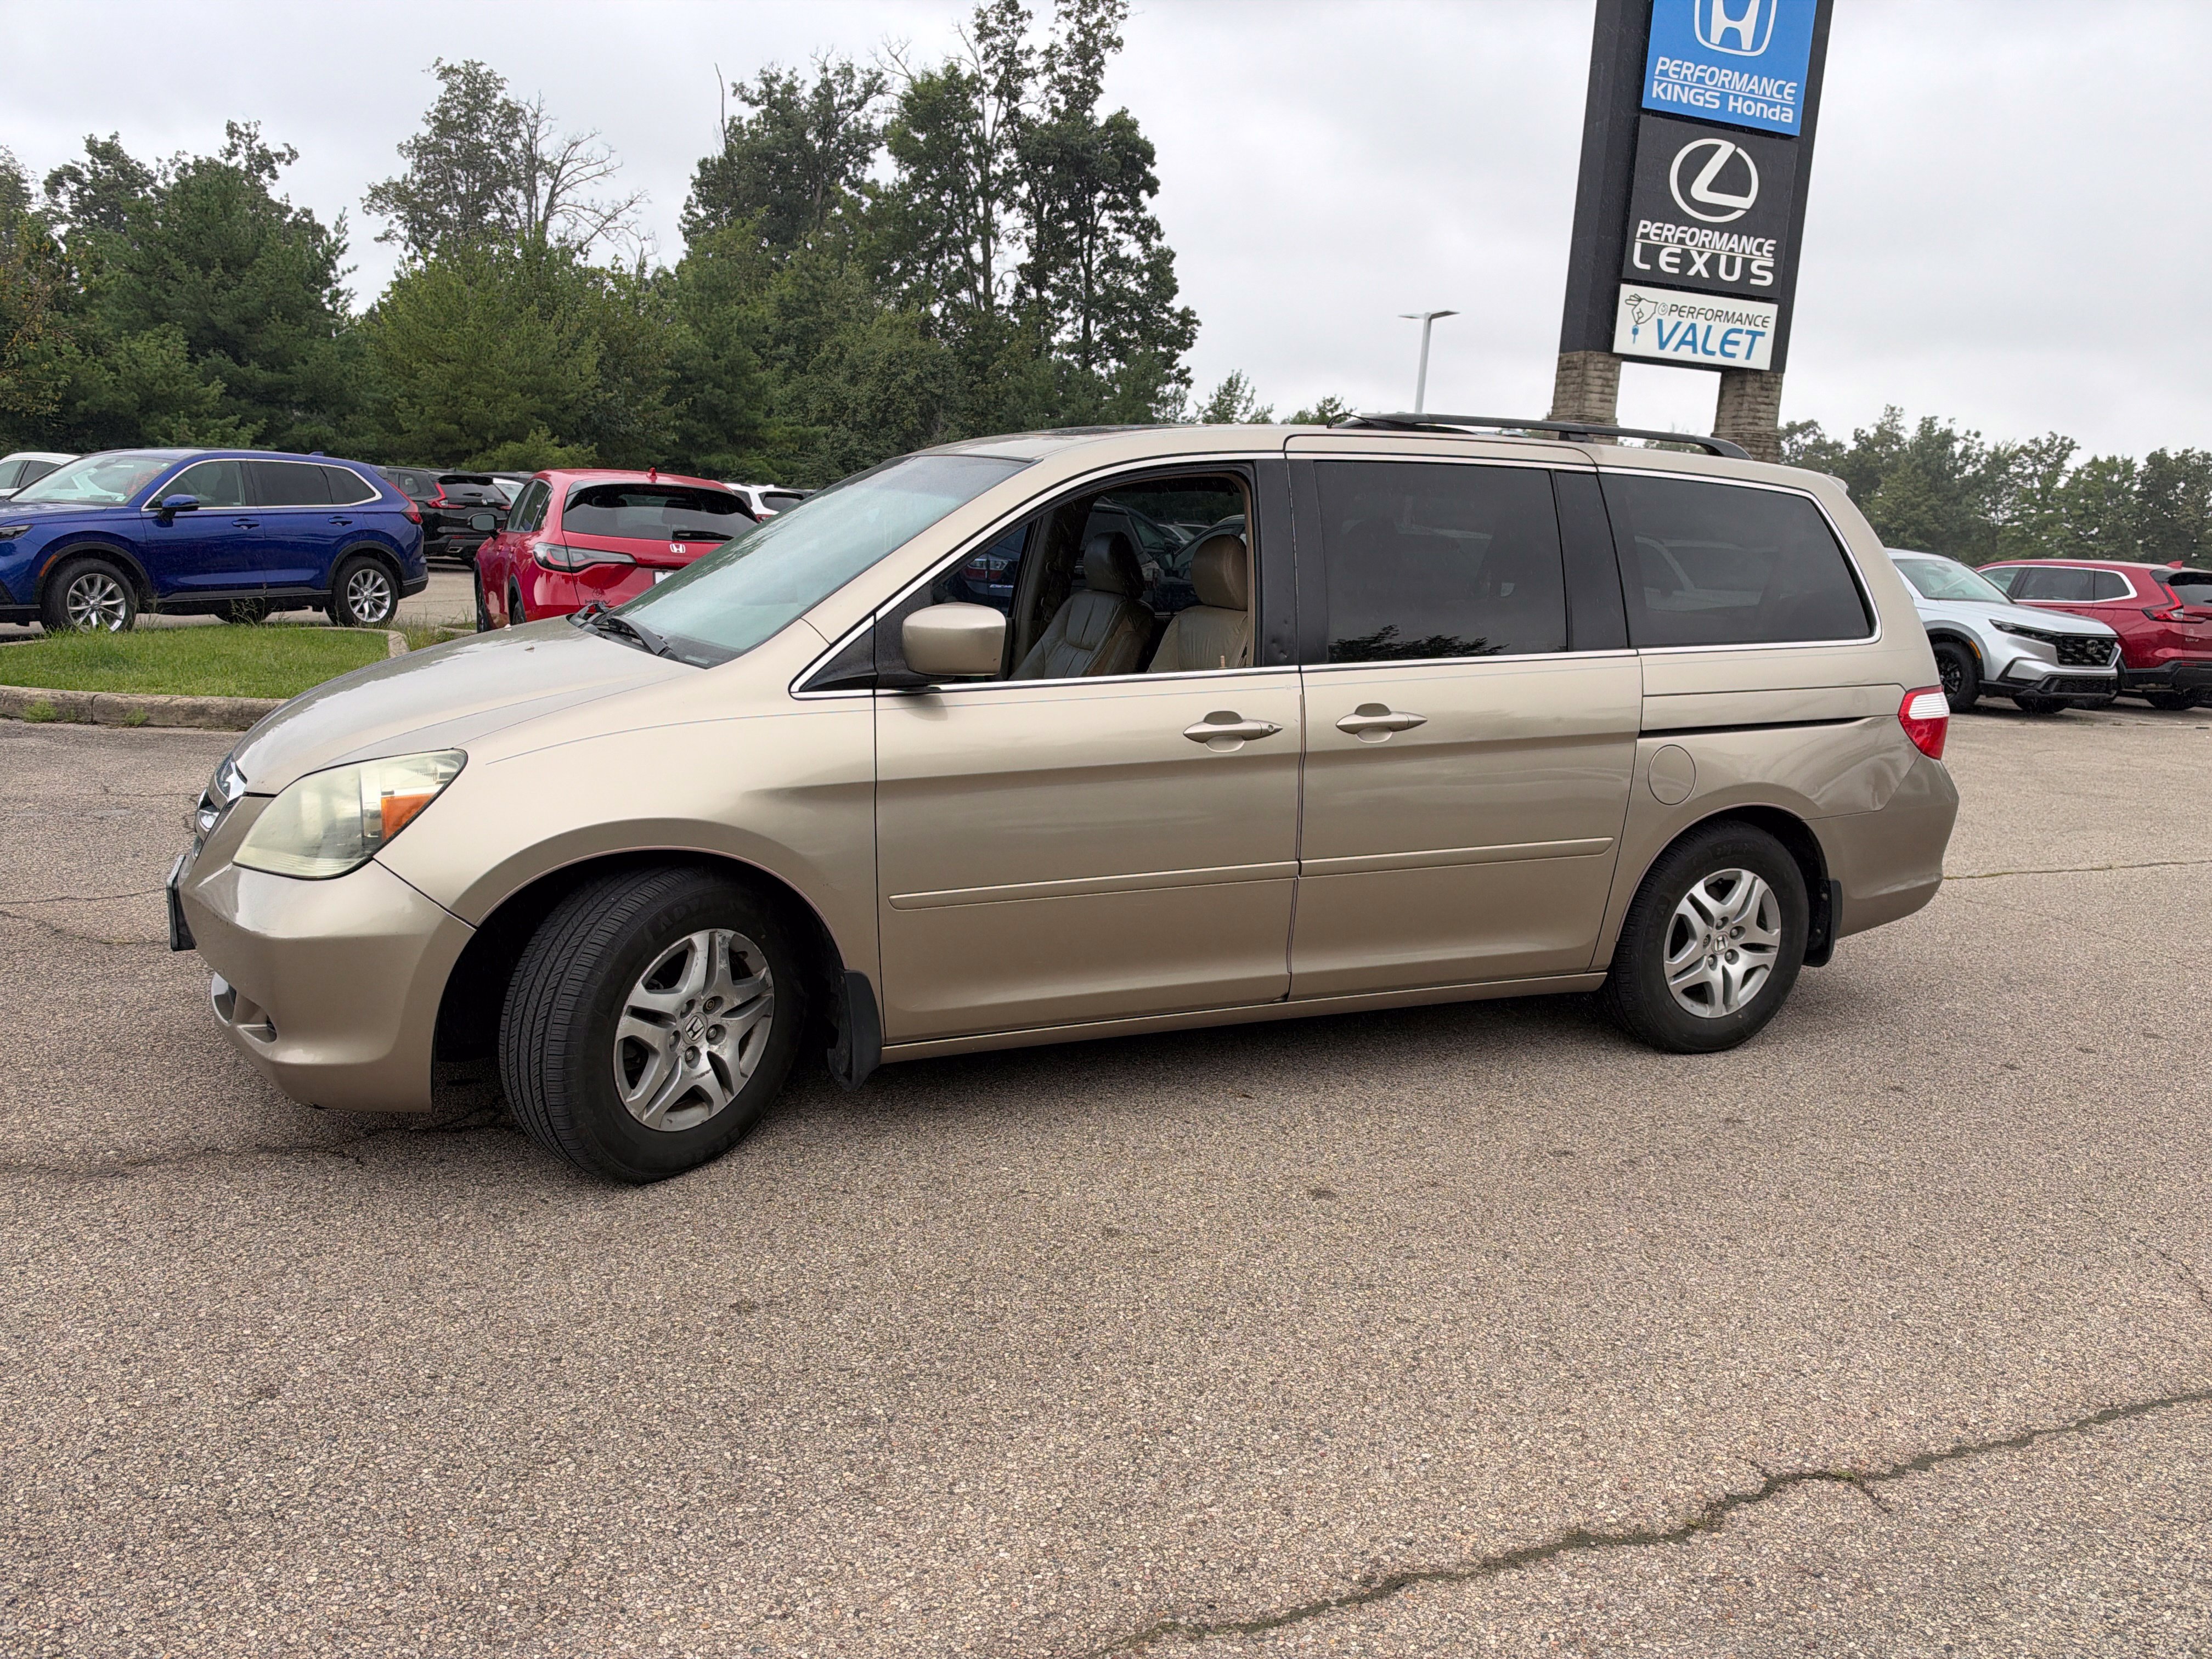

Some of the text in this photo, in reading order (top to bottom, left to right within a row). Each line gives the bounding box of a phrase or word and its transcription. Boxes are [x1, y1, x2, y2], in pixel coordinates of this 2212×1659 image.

[1655, 56, 1798, 101] PERFORMANCE
[1652, 81, 1793, 123] KINGS Honda
[1636, 219, 1776, 258] PERFORMANCE
[1633, 242, 1774, 286] LEXUS
[1668, 304, 1771, 328] PERFORMANCE
[1657, 318, 1766, 360] VALET
